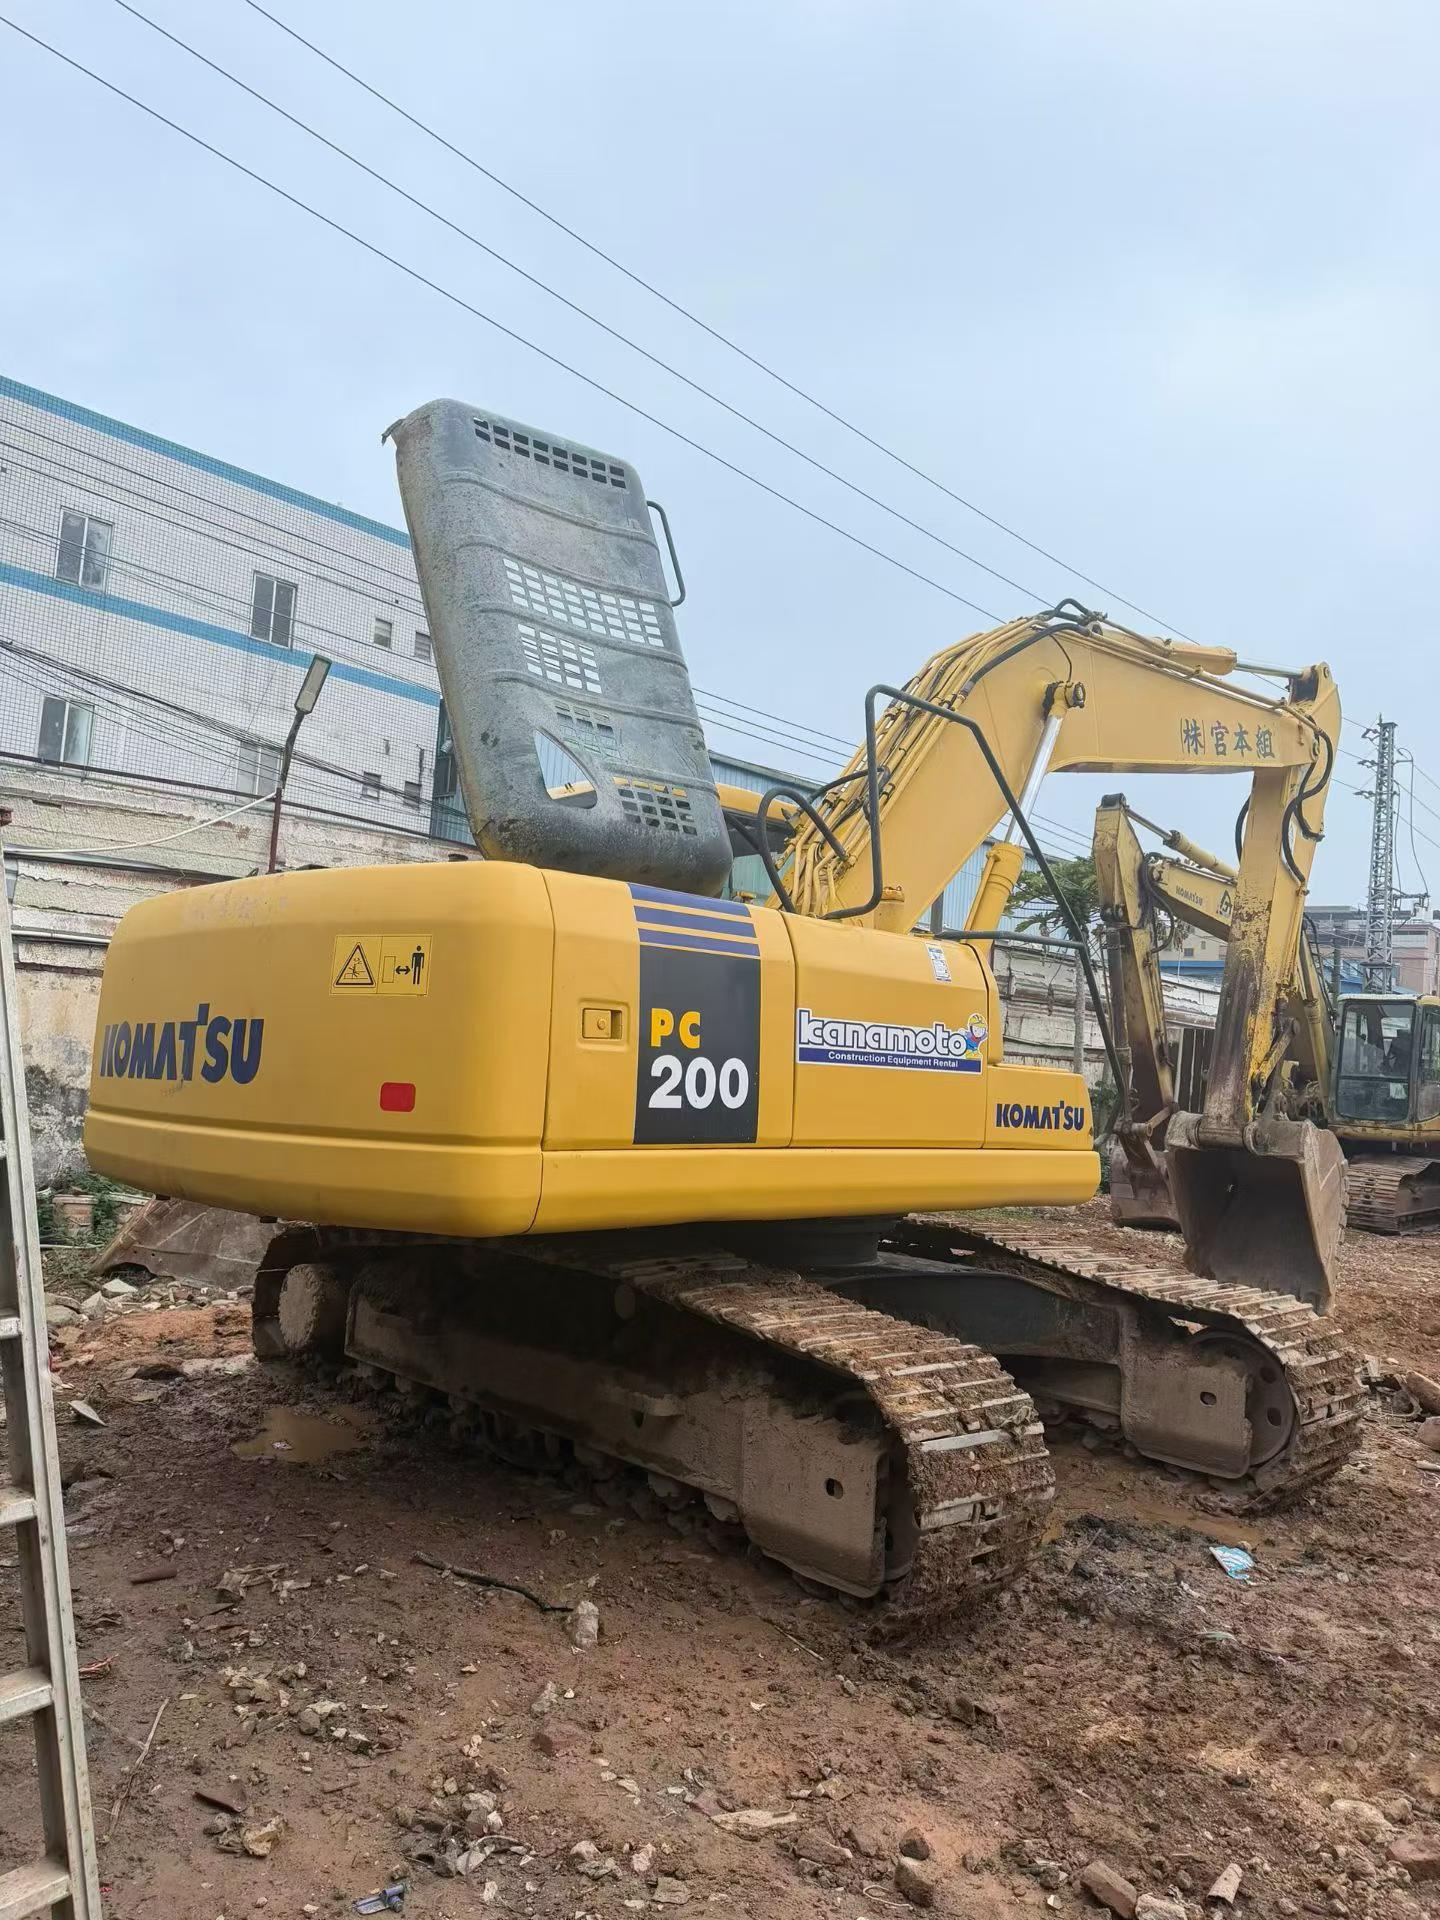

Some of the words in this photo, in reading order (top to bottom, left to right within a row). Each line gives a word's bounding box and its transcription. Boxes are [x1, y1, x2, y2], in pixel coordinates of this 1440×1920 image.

[100, 1003, 264, 1084] KOMATSU
[650, 1007, 701, 1049] PC
[799, 1009, 968, 1057] kanamoto
[648, 1054, 749, 1109] 200
[828, 1051, 886, 1063] Construction
[887, 1055, 932, 1067] Equipment
[933, 1059, 959, 1068] Rental
[996, 1100, 1085, 1131] KOMATSU
